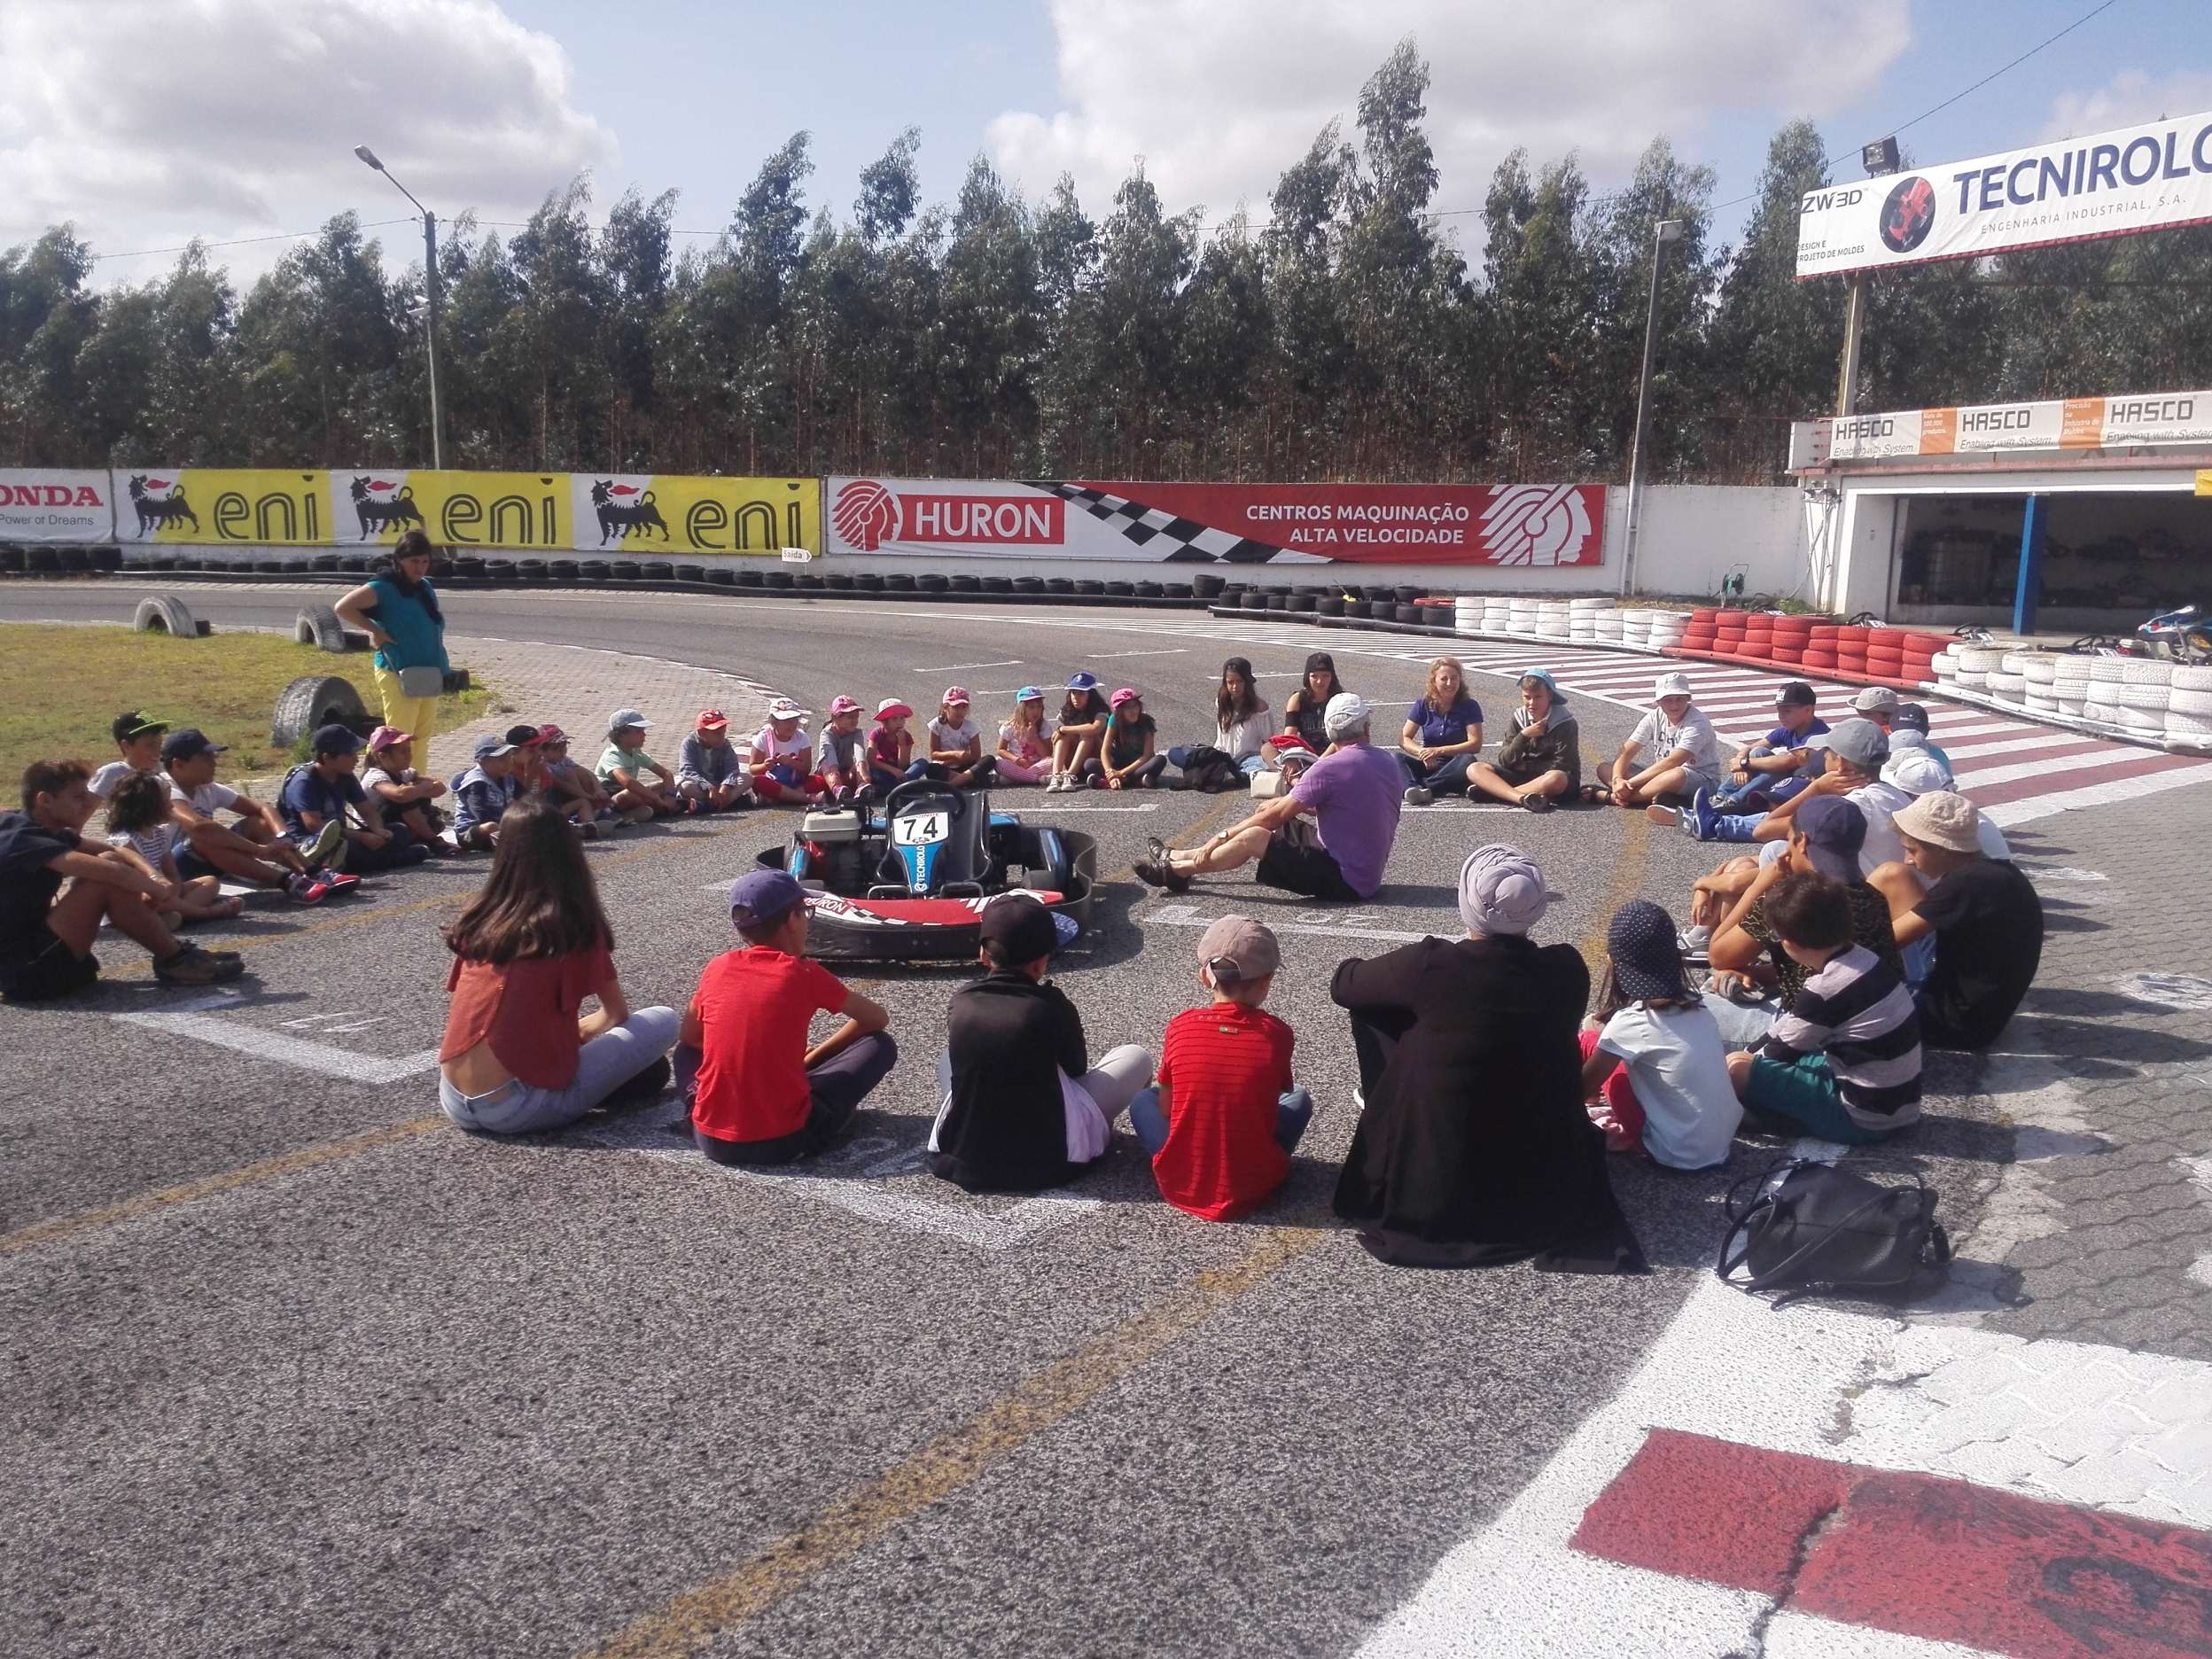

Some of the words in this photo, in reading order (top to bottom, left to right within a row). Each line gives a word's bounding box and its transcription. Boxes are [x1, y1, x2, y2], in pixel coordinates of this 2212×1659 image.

[1801, 189, 1863, 214] ZW3D
[1981, 214, 2060, 234] ENGENHARIA
[1826, 249, 1836, 258] DE
[1837, 245, 1865, 257] MOLDES
[1962, 409, 2030, 432] HASCO
[2111, 400, 2193, 424] HASCO
[1835, 419, 1894, 440] HASCO
[35, 514, 45, 525] of
[48, 514, 95, 526] Dreams
[214, 475, 318, 541] eni
[442, 478, 557, 544] eni
[686, 483, 801, 549] eni
[915, 502, 1051, 538] HURON
[1246, 505, 1332, 520] CENTROS
[1336, 502, 1470, 525] MAQUINAÇÃO
[1289, 528, 1339, 543] ALTA
[1343, 527, 1464, 544] VELOCIDADE
[904, 816, 938, 840] 74
[916, 845, 926, 882] TECNIROLO
